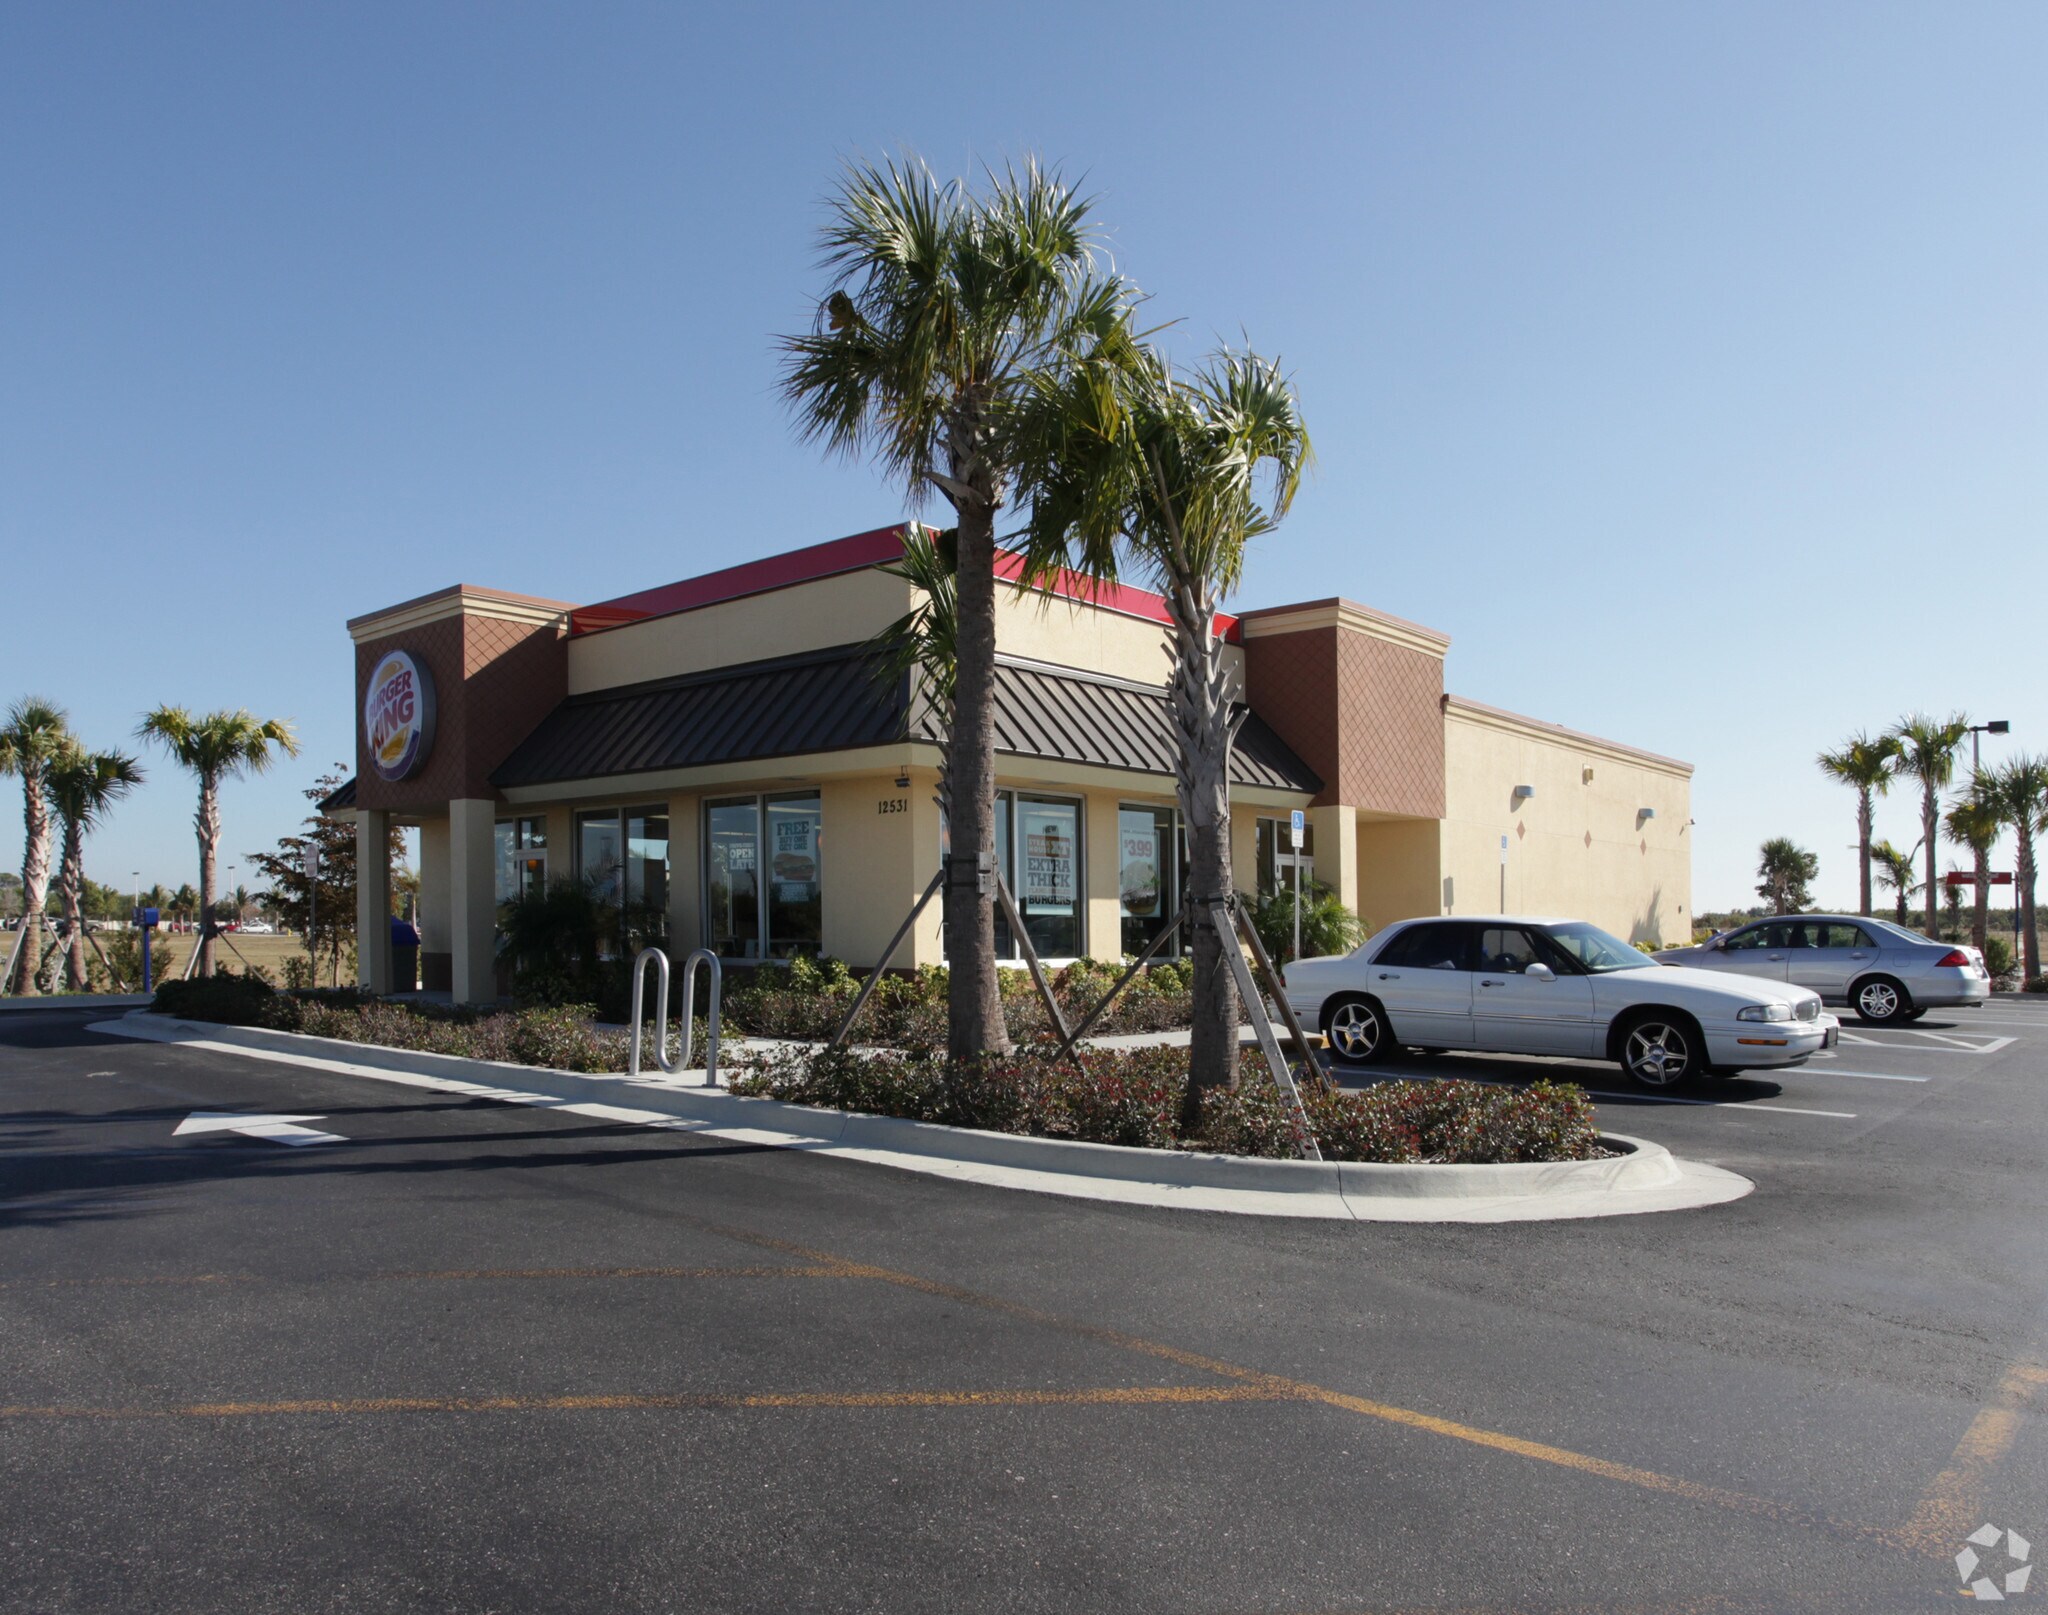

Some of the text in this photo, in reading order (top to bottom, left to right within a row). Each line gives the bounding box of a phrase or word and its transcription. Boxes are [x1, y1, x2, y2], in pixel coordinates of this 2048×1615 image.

[369, 670, 412, 727] BURGER
[371, 690, 414, 757] KING
[878, 798, 908, 815] 12531
[776, 821, 809, 836] FREE
[794, 835, 808, 843] ONE
[729, 848, 755, 859] OPEN
[779, 843, 792, 851] GET
[729, 859, 755, 870] LATE
[1027, 857, 1071, 873] EXTRA
[1027, 871, 1071, 888] THICK
[1028, 894, 1072, 906] BURGERS
